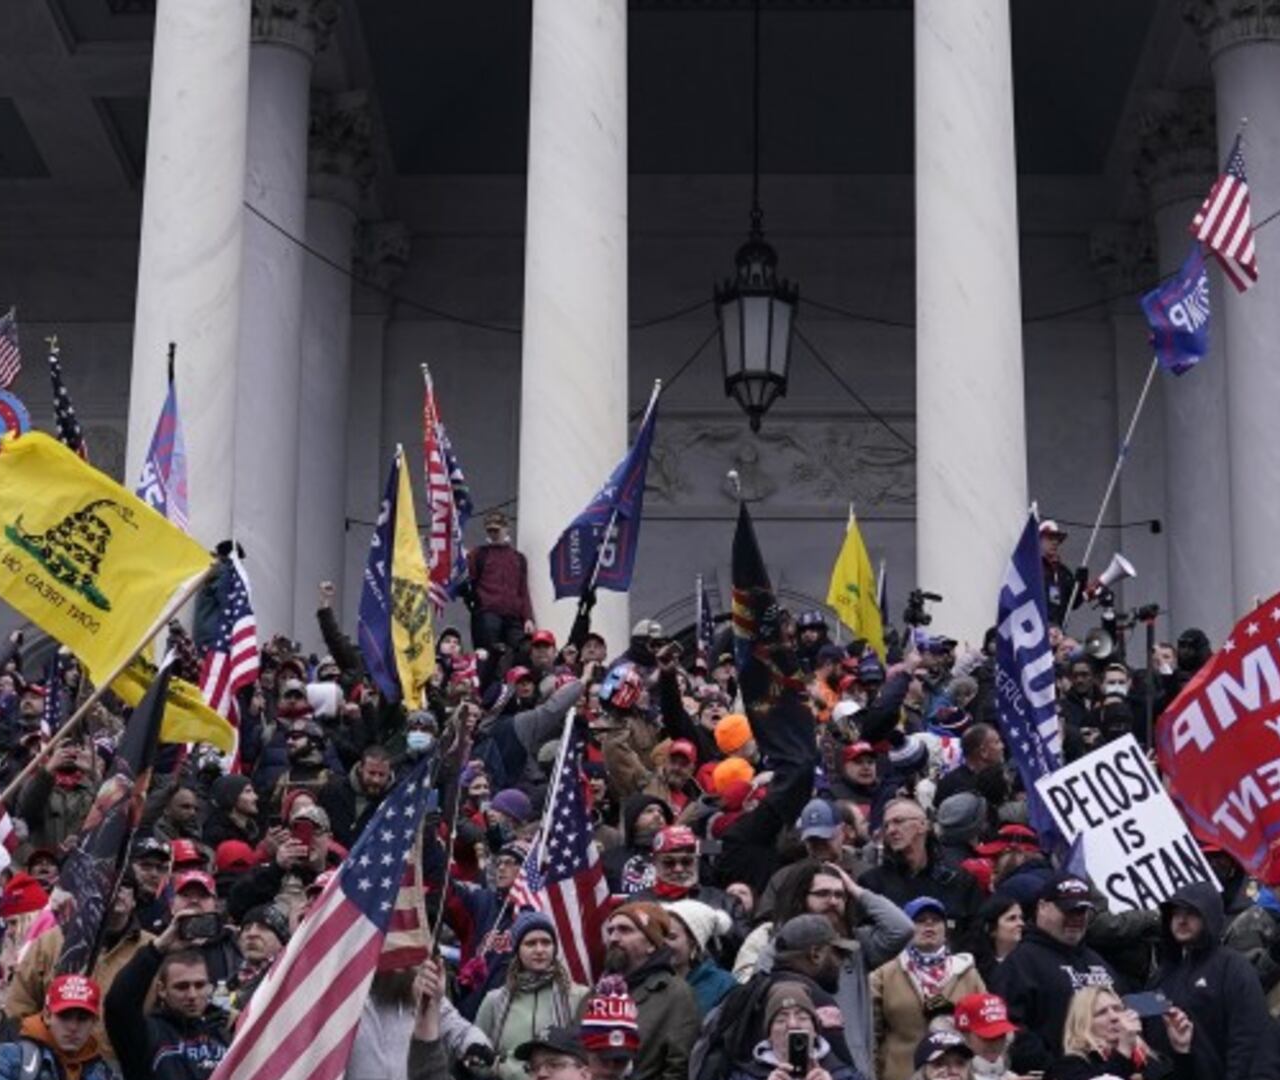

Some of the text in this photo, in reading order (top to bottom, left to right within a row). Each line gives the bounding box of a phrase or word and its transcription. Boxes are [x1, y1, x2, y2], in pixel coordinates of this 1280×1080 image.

[1047, 745, 1160, 834] PELOSI
[1106, 834, 1209, 912] SATAN
[1114, 817, 1145, 855] IS
